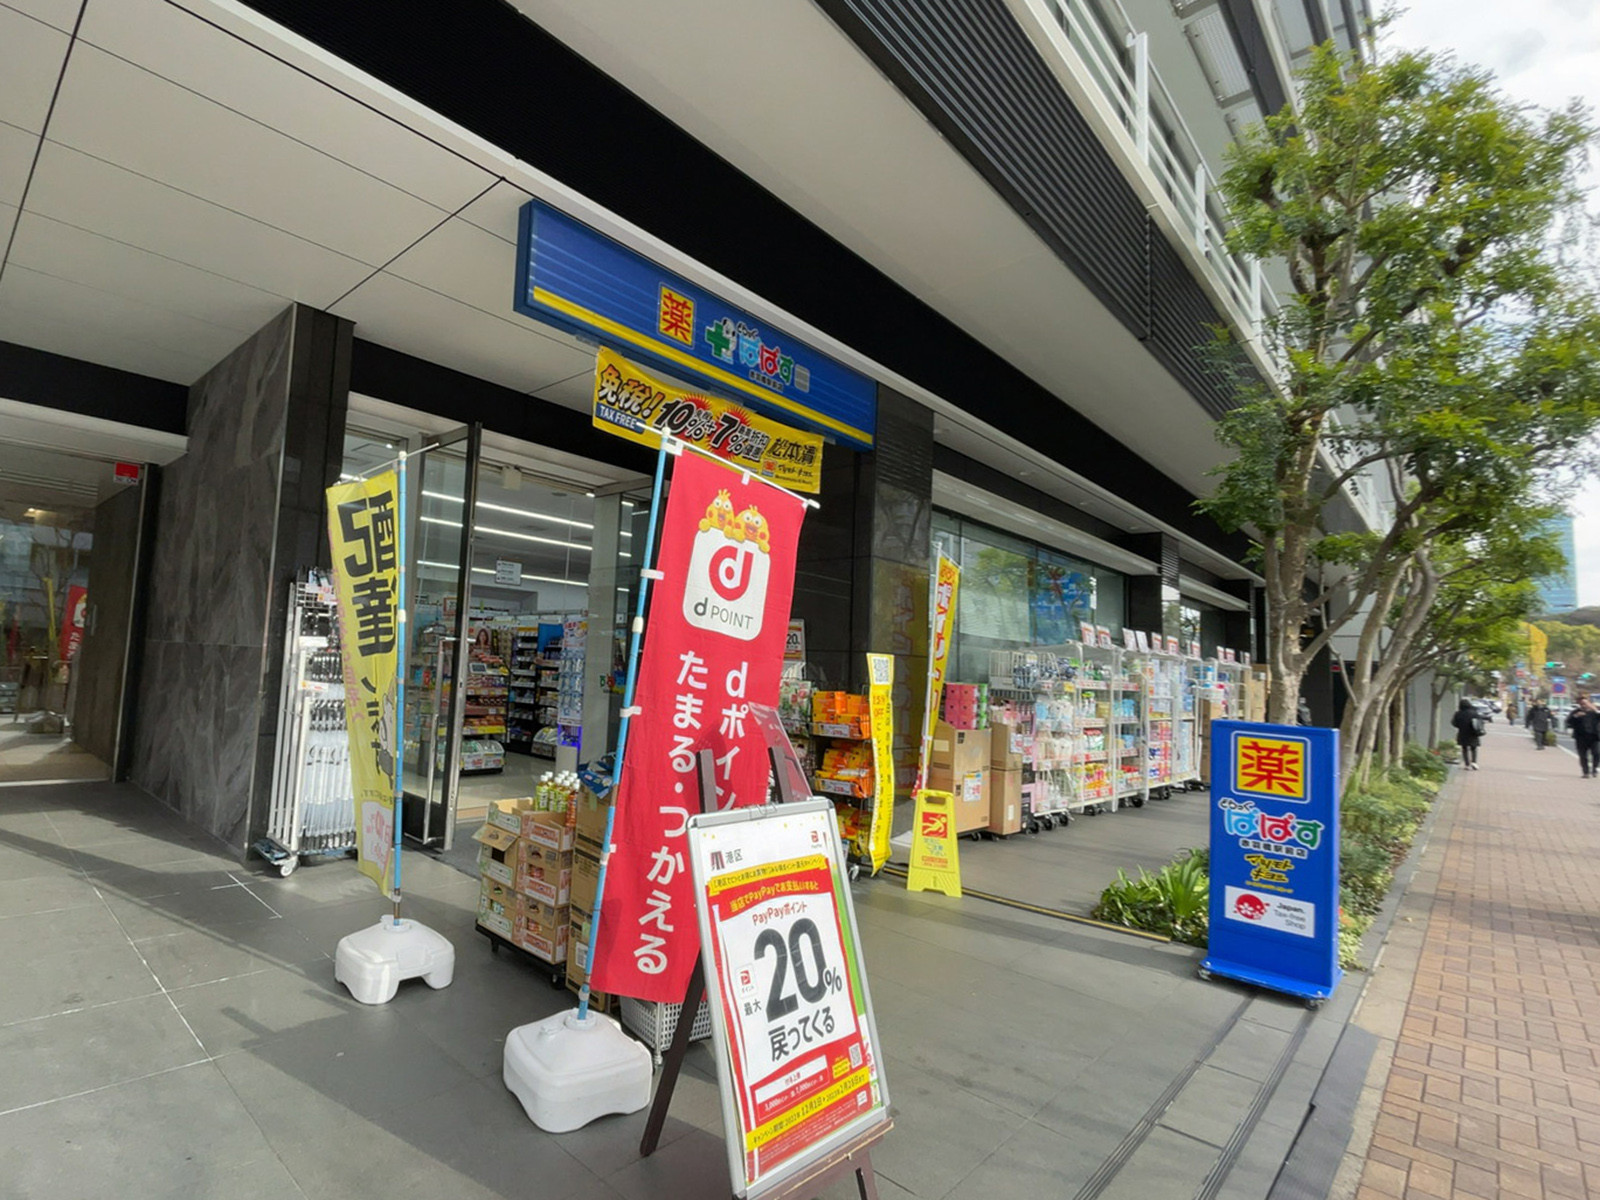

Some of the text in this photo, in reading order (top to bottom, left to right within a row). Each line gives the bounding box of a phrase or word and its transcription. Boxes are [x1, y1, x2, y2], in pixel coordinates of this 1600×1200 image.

[662, 292, 692, 342] 薬
[740, 335, 793, 384] ぱぱす
[600, 405, 637, 429] TAX FREE
[694, 597, 753, 630] d POINT
[1241, 741, 1299, 793] 薬
[633, 651, 709, 975] たまる・つかえる
[1226, 808, 1322, 848] ぱぱす
[726, 849, 743, 865] 港区
[752, 901, 807, 926] PayPayポイント
[744, 999, 762, 1016] 最大
[768, 1006, 835, 1061] 戻ってくる
